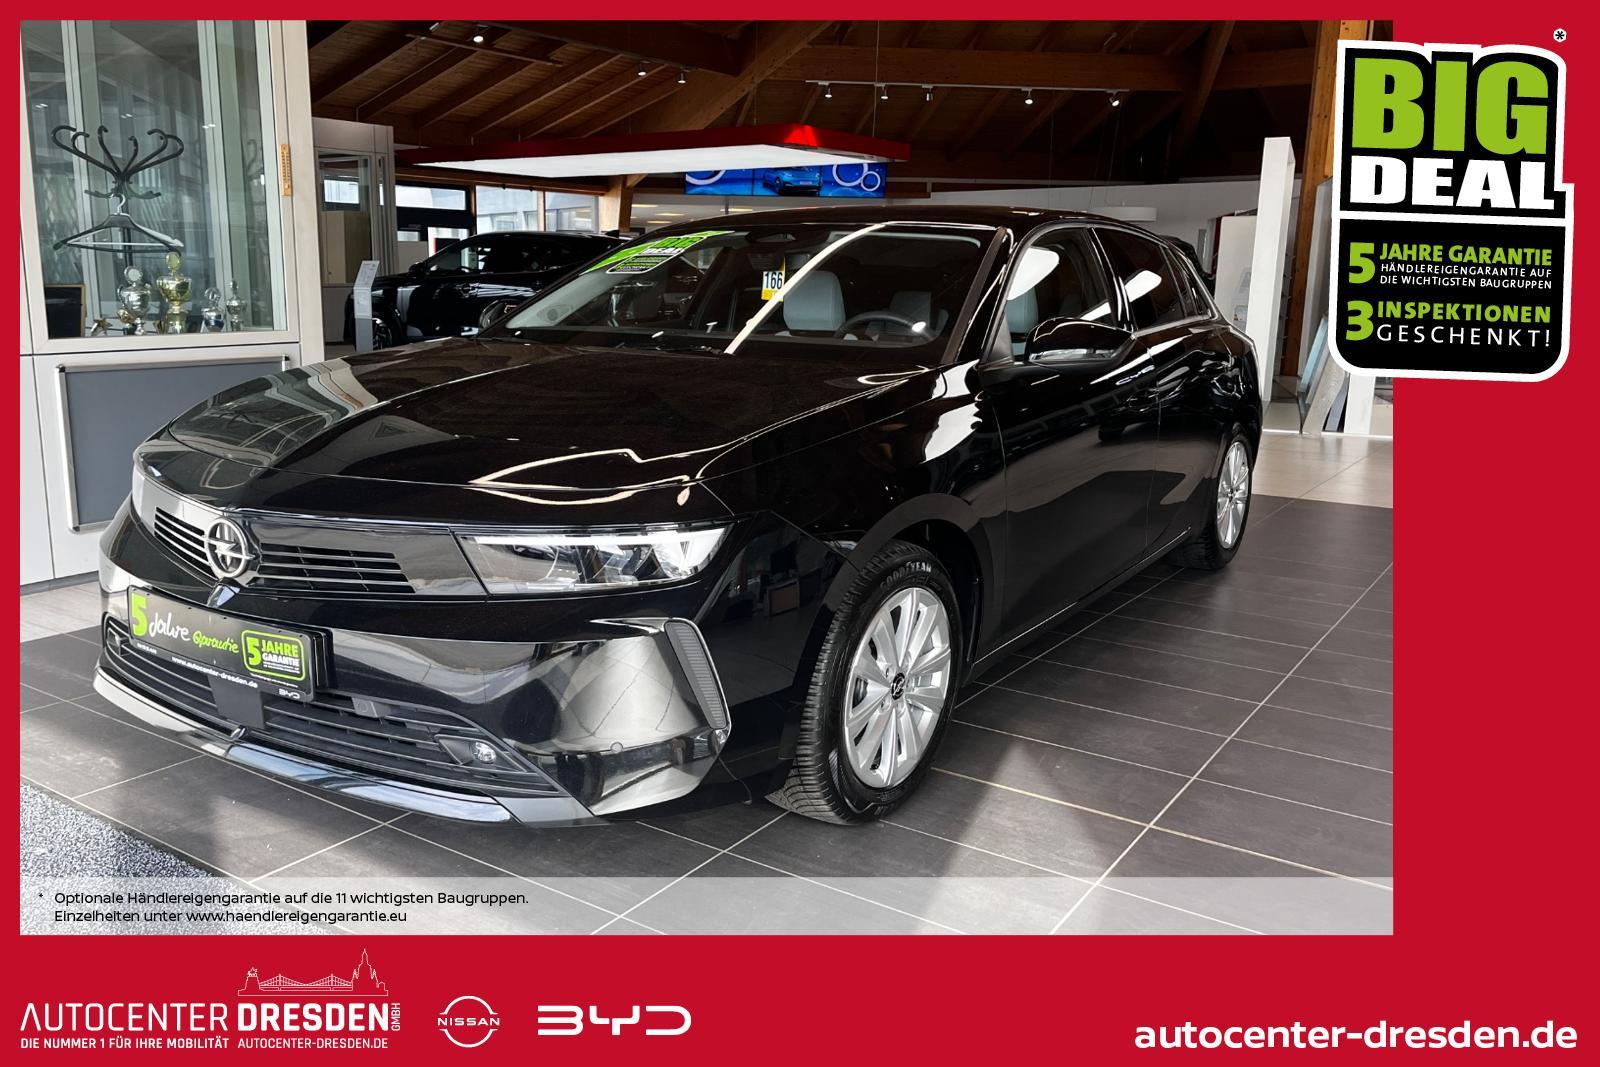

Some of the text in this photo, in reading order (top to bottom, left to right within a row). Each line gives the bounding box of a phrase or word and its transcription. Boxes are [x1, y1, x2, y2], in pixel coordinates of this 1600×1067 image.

[764, 271, 783, 290] 166
[132, 592, 148, 637] 5
[246, 636, 299, 666] 5 JAHRE
[262, 652, 300, 667] GARANTIE
[171, 656, 259, 689] www.autocenter-dresden.de
